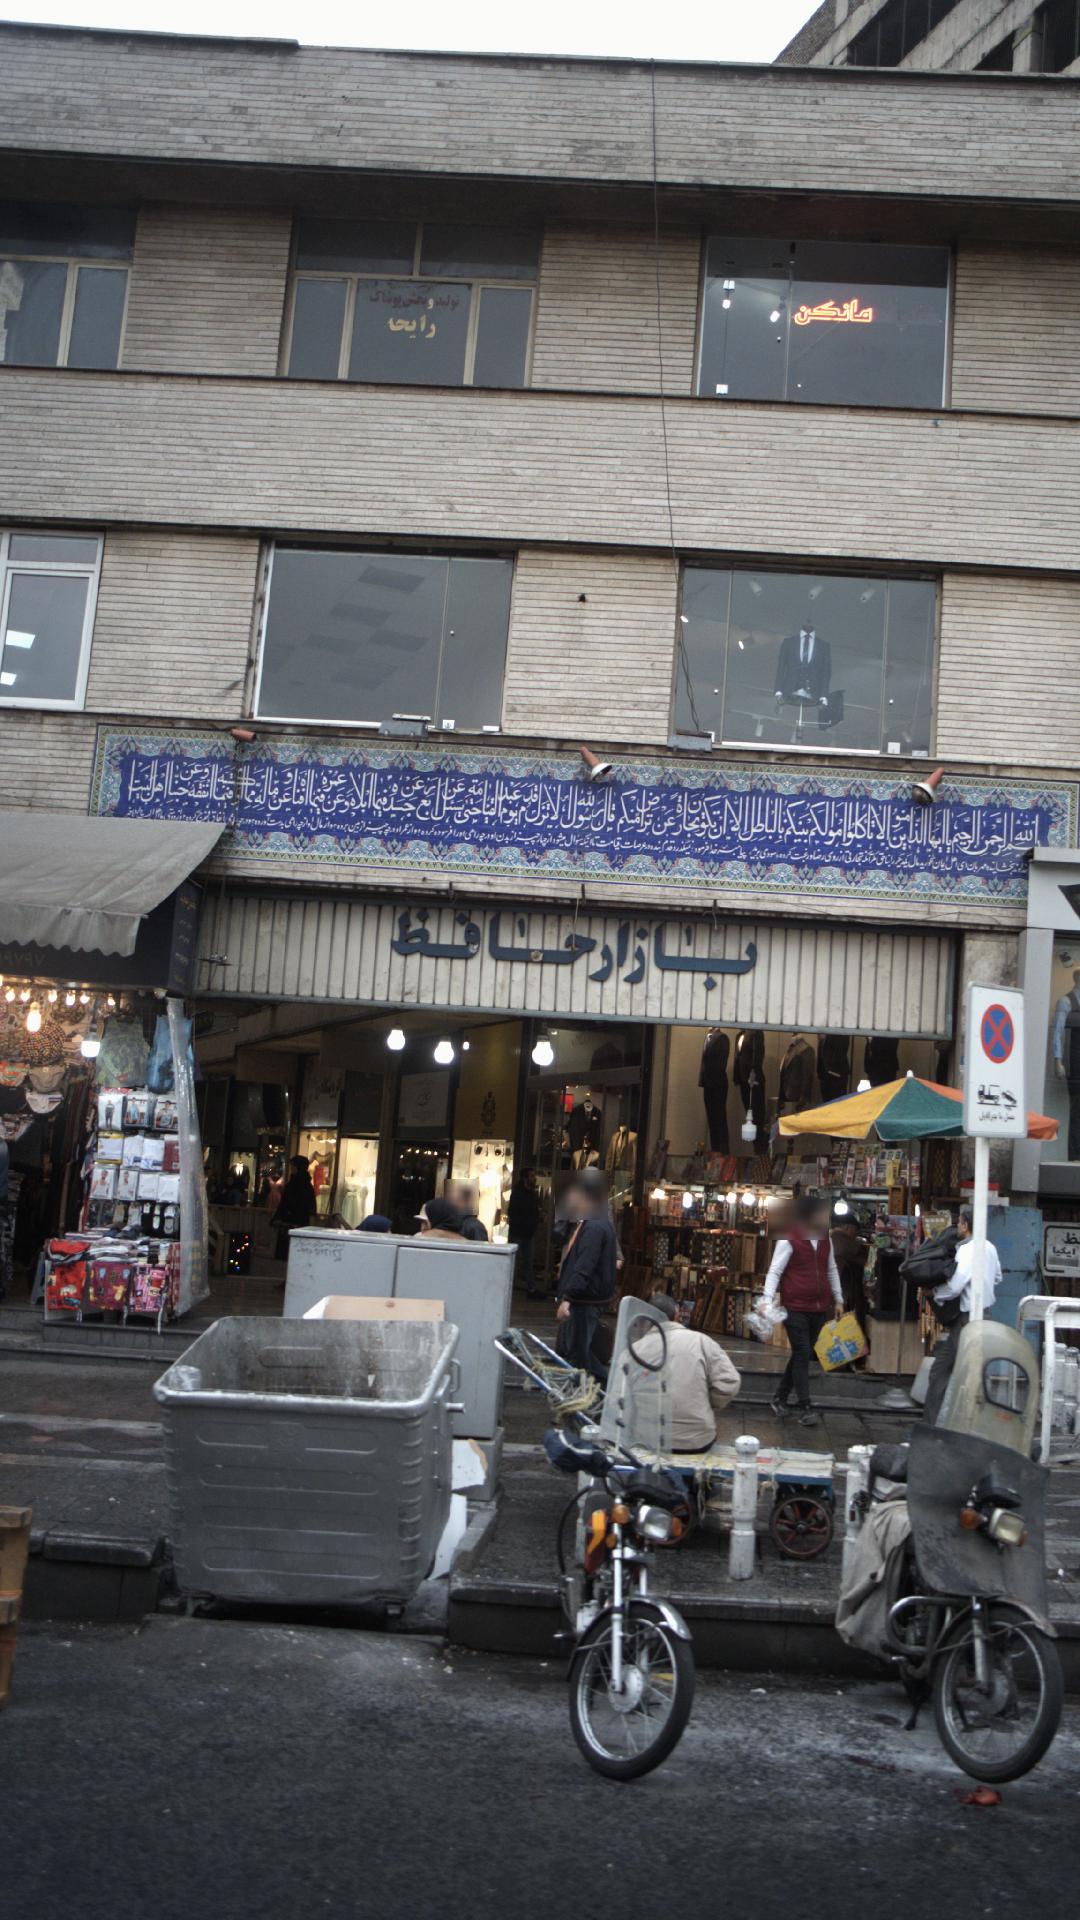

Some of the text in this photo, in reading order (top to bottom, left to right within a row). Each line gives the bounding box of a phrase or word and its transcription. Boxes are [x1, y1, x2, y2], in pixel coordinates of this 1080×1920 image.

[794, 299, 873, 326] مانکن
[391, 909, 757, 991] بازار حافظ
